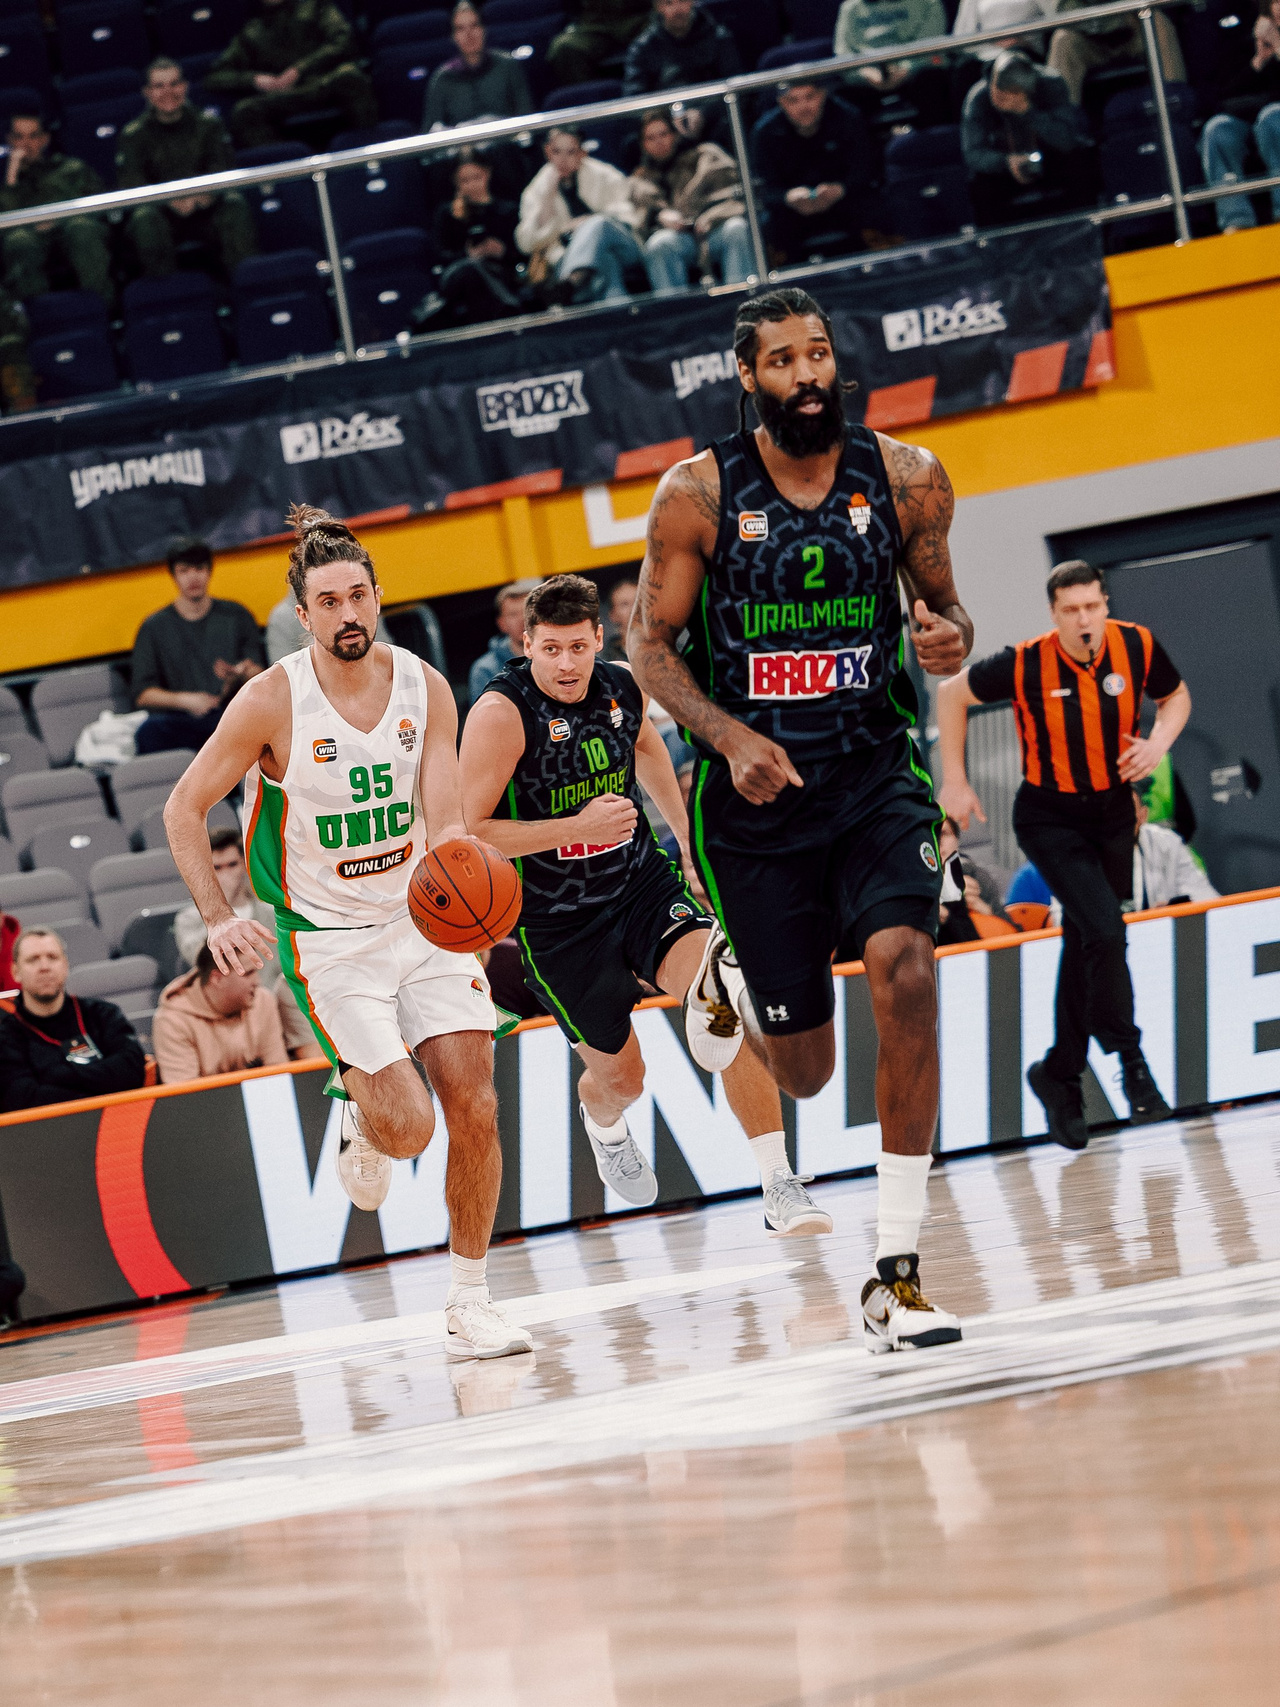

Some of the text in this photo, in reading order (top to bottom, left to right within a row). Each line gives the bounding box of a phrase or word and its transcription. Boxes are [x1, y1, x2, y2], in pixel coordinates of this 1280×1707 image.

[70, 448, 206, 510] УРАЛМАШ
[802, 545, 825, 590] 2
[743, 594, 877, 640] URALMASH
[318, 746, 336, 755] WIN
[581, 737, 610, 774] 10
[349, 762, 394, 804] 95
[550, 765, 628, 816] URALMAS
[315, 801, 415, 850] UNIC
[344, 851, 403, 877] WINLINE
